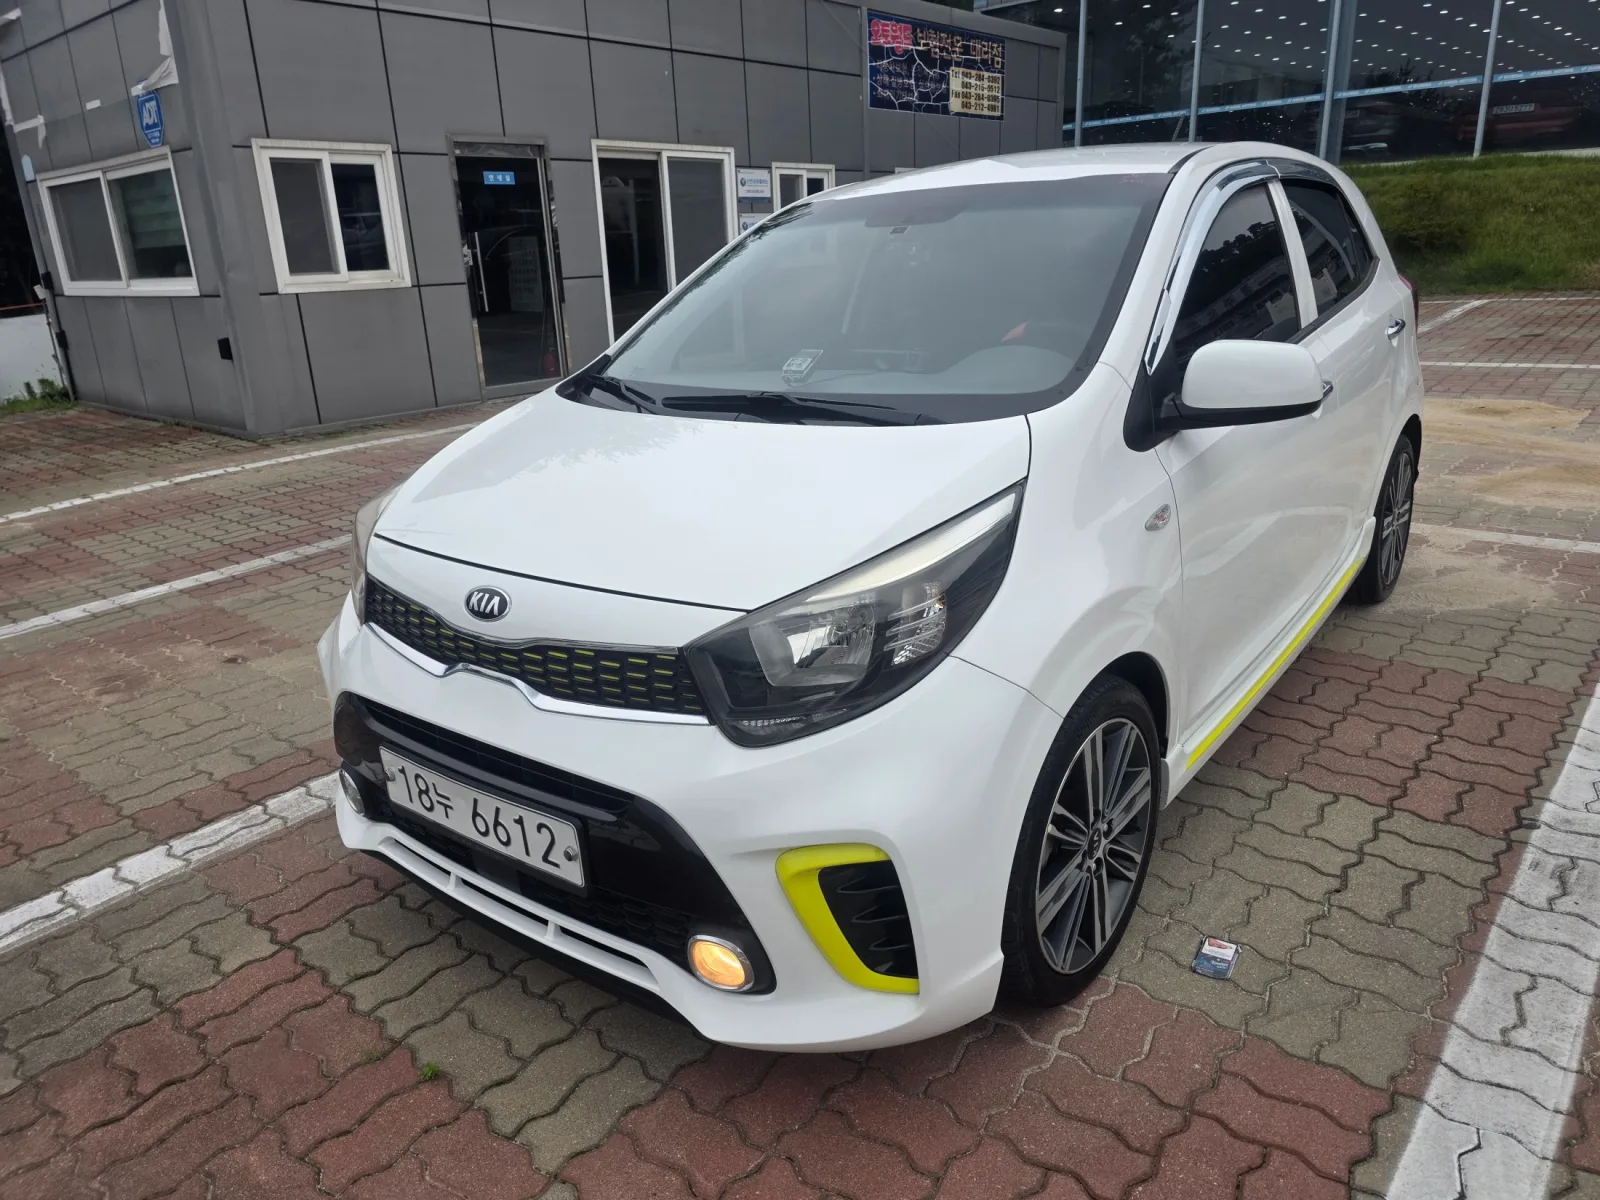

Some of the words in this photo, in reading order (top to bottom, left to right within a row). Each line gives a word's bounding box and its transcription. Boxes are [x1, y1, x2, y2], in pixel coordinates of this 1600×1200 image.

[917, 28, 963, 60] 보험전문
[970, 39, 1002, 69] 대리점
[143, 100, 158, 125] ADT
[468, 591, 501, 616] KIA
[398, 764, 454, 819] 18누
[471, 797, 561, 869] 6612
